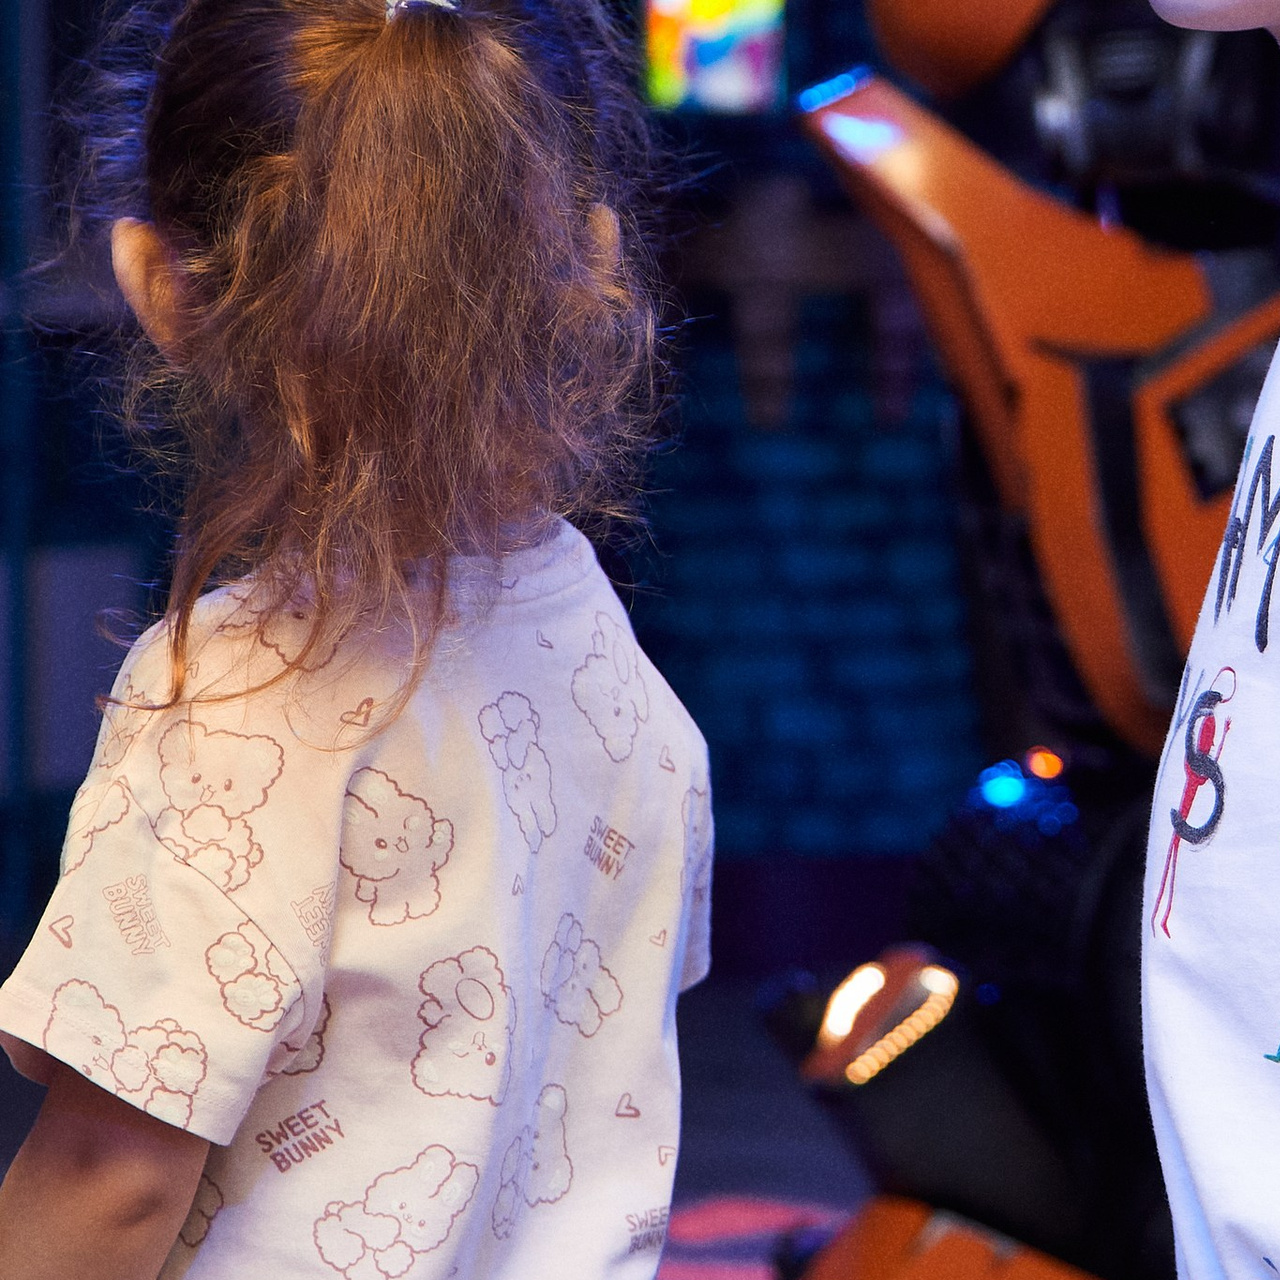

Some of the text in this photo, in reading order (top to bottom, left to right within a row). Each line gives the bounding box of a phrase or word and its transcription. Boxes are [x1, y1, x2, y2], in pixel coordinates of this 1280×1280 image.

[584, 835, 625, 880] BUNNY
[590, 815, 636, 860] SWEET
[102, 882, 155, 956] BUNNY
[125, 873, 171, 948] SWEET
[255, 1099, 330, 1153] SWEET
[269, 1118, 345, 1174] BUNNY
